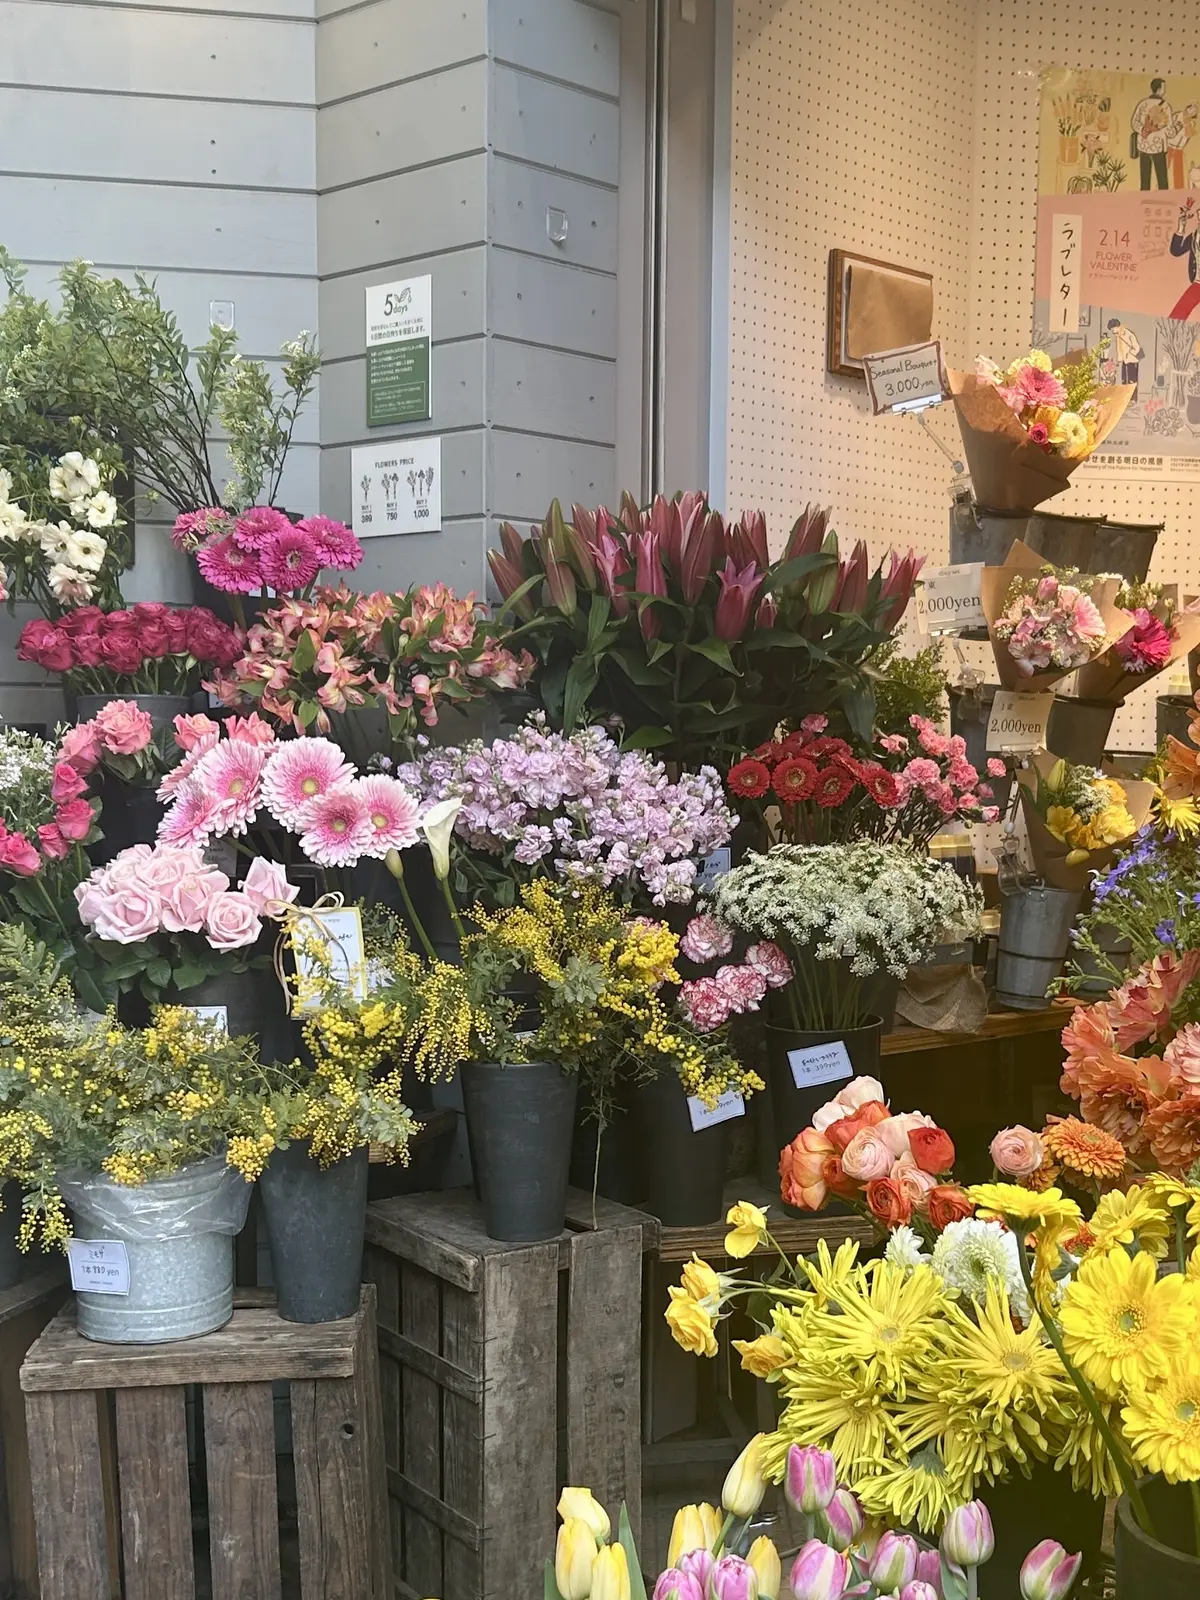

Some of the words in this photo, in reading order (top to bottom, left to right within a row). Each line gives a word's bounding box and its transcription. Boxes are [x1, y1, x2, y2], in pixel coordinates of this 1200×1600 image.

[1099, 229, 1131, 247] 2.14
[1095, 250, 1132, 261] FLOWER
[1060, 222, 1076, 326] ラブレター
[1089, 260, 1138, 272] VALENTINE
[384, 293, 393, 316] 5
[393, 302, 408, 316] days
[871, 361, 904, 380] Seasonal
[904, 359, 938, 372] Bouquet
[375, 460, 398, 469] FLOWERS
[399, 457, 414, 466] PRICE
[386, 512, 398, 521] 750
[413, 508, 430, 520] 1,000
[918, 595, 981, 615] 2,000yen
[990, 718, 1042, 736] 2,000yen
[89, 1245, 105, 1260] ミモザ
